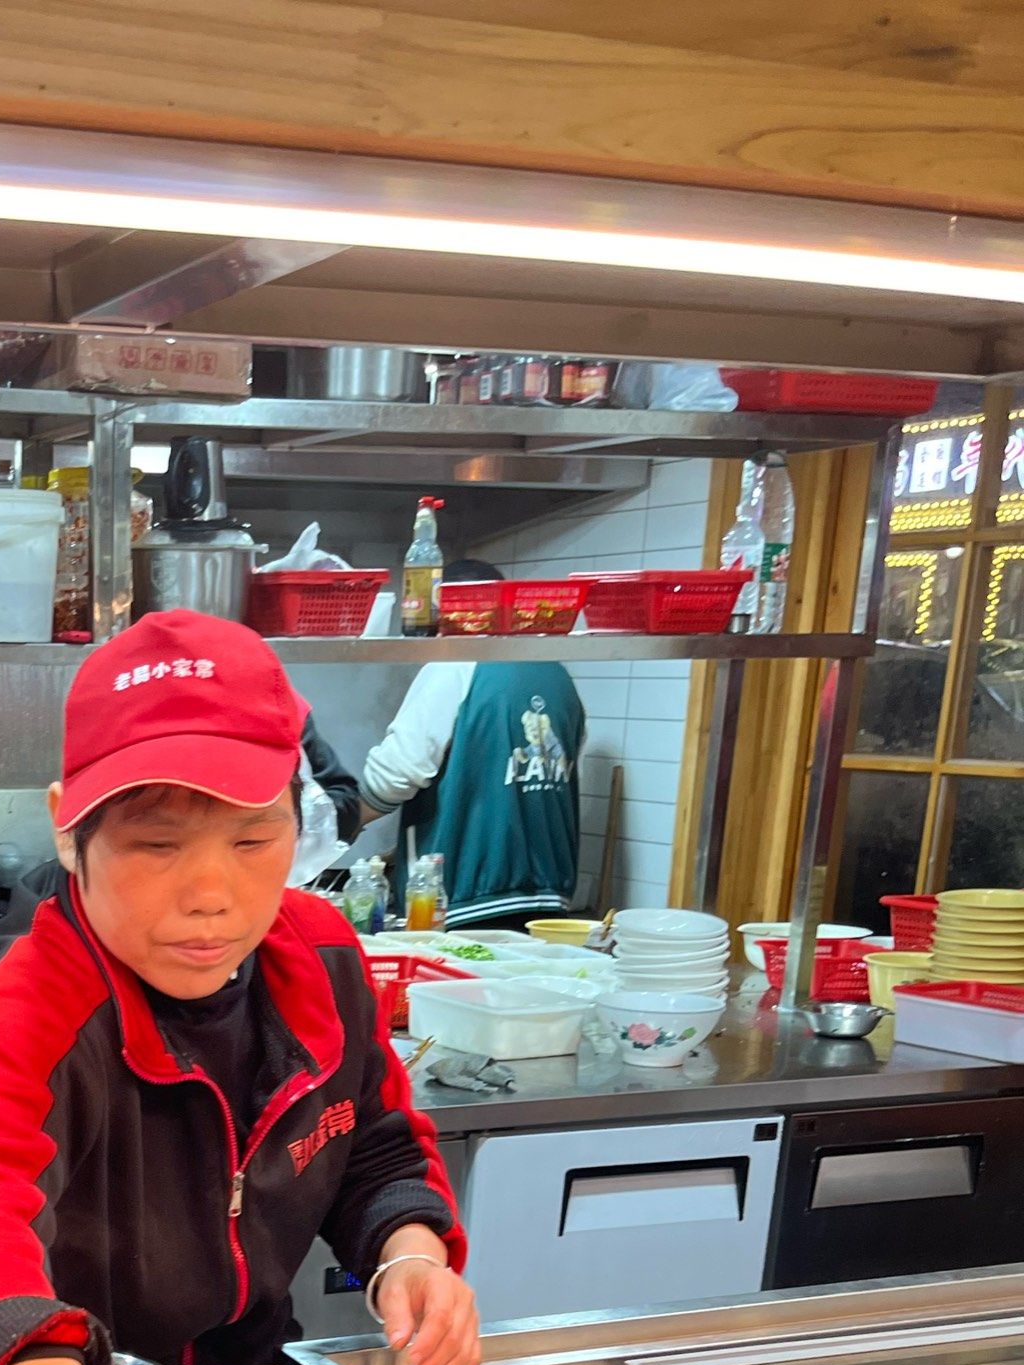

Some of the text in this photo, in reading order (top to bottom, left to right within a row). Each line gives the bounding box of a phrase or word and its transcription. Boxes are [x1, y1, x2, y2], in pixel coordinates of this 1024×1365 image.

[113, 658, 215, 692] 老易小家常
